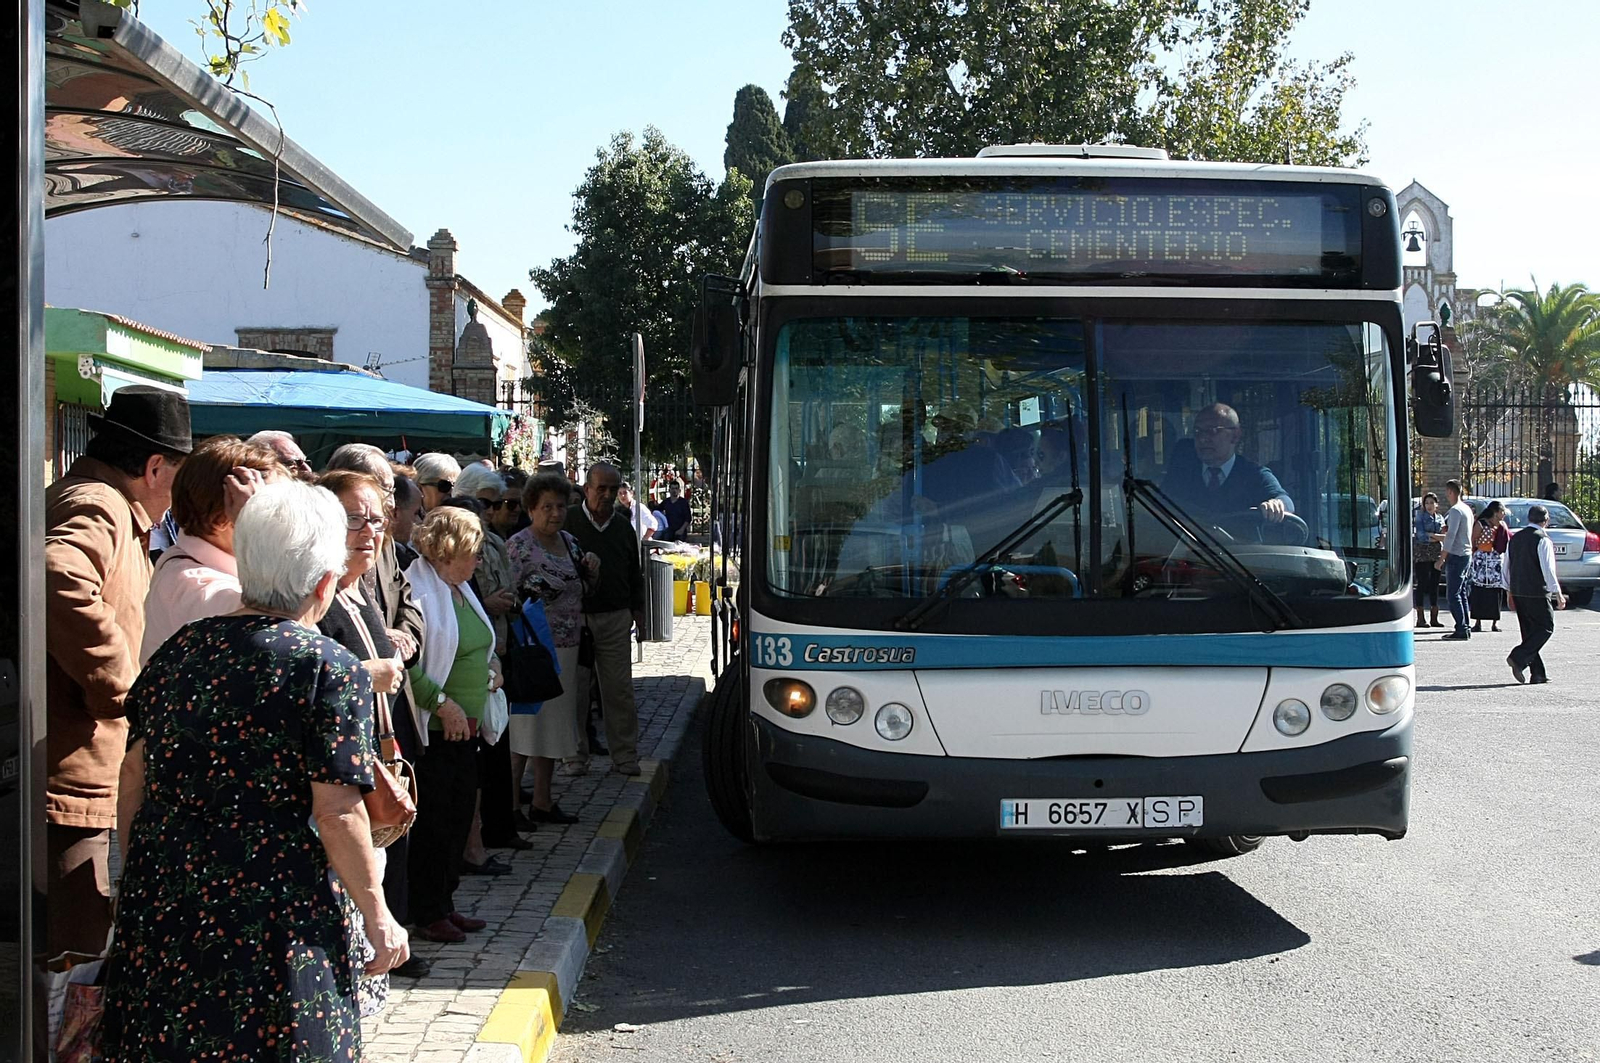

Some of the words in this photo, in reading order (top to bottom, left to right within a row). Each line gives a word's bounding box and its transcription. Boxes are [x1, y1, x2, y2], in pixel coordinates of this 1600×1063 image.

[981, 195, 1154, 226] SERVICIO
[1026, 229, 1248, 261] CEMENTERIO
[755, 635, 793, 667] 133
[804, 643, 916, 664] Castrosua
[1041, 690, 1150, 715] IVECO
[1015, 802, 1029, 825] H
[1049, 802, 1108, 825] 6657
[1126, 802, 1140, 825] X
